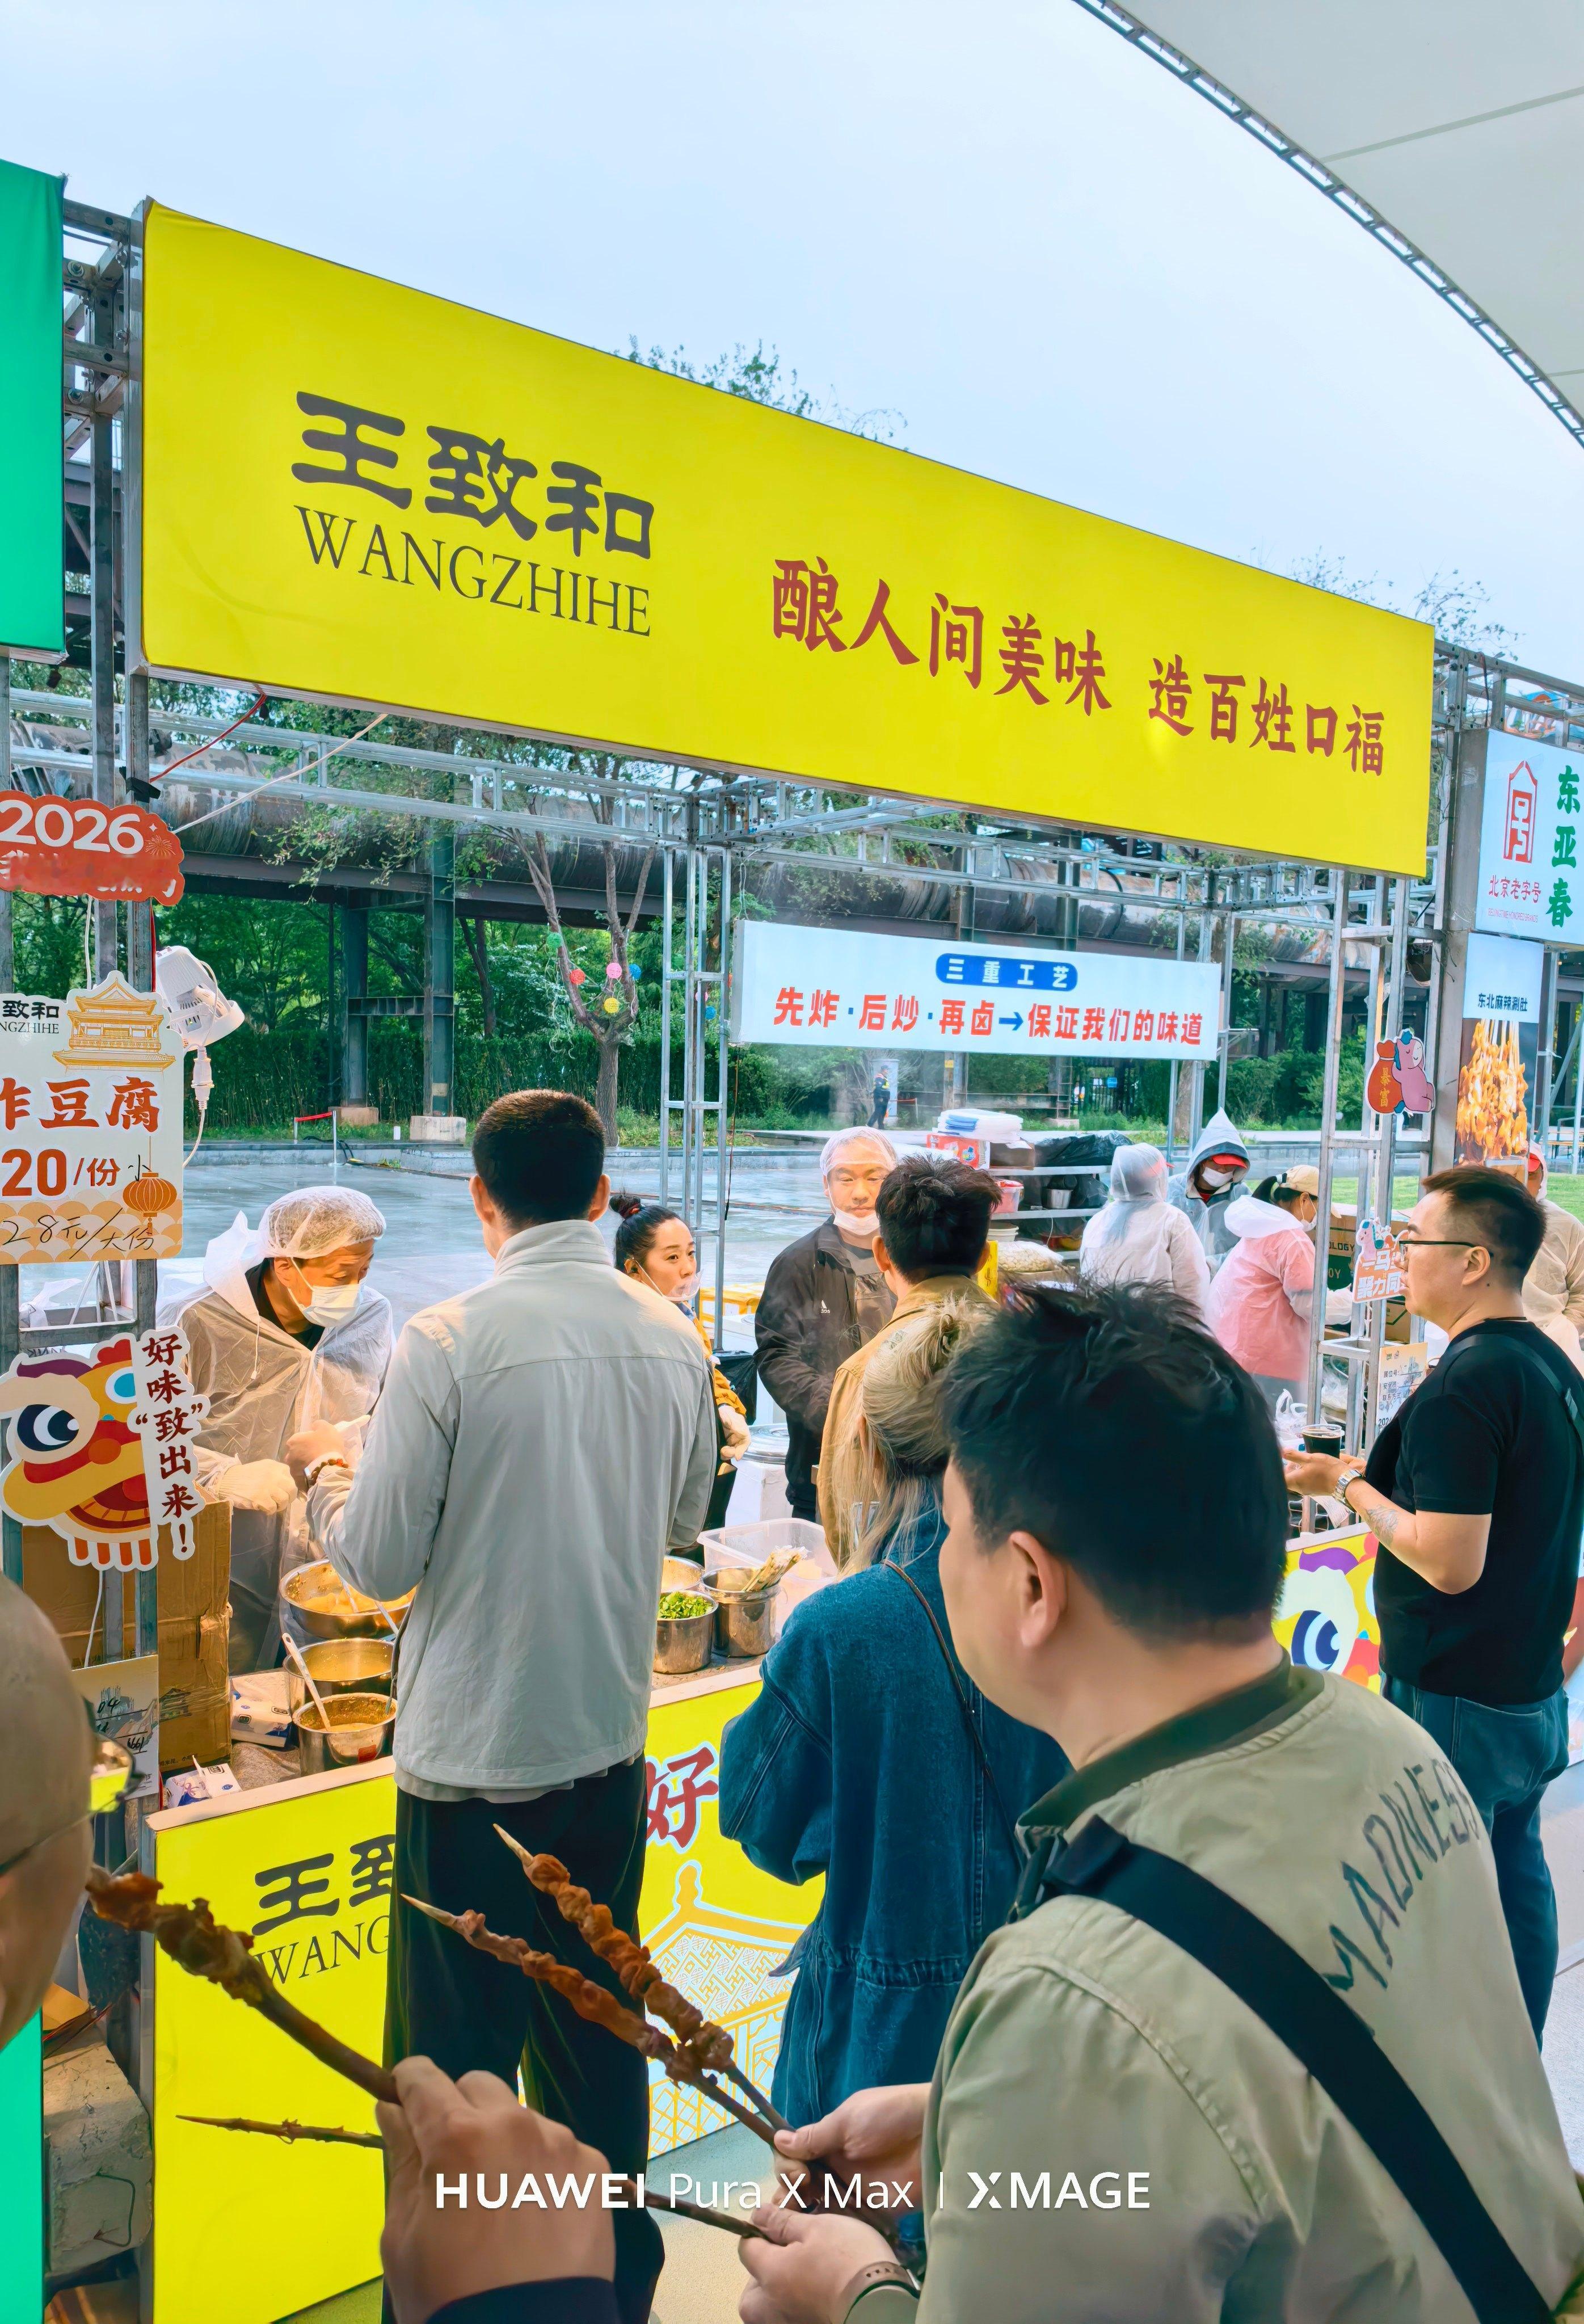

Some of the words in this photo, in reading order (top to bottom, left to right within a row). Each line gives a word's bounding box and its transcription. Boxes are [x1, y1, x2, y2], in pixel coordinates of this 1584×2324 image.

[292, 391, 654, 559] 王致和
[293, 505, 651, 637] WANGZHIHE
[772, 556, 1112, 717] 酿人间美味
[1149, 654, 1385, 776] 造百姓口福
[0, 799, 144, 854] 2026
[1545, 765, 1581, 928] 东亚春
[1488, 874, 1541, 904] 北京老字号
[945, 958, 1070, 989] 三重工艺
[1477, 992, 1528, 1012] 东北麻辣涮肚
[1, 1148, 121, 1197] 20/份
[646, 1747, 719, 1849] 好
